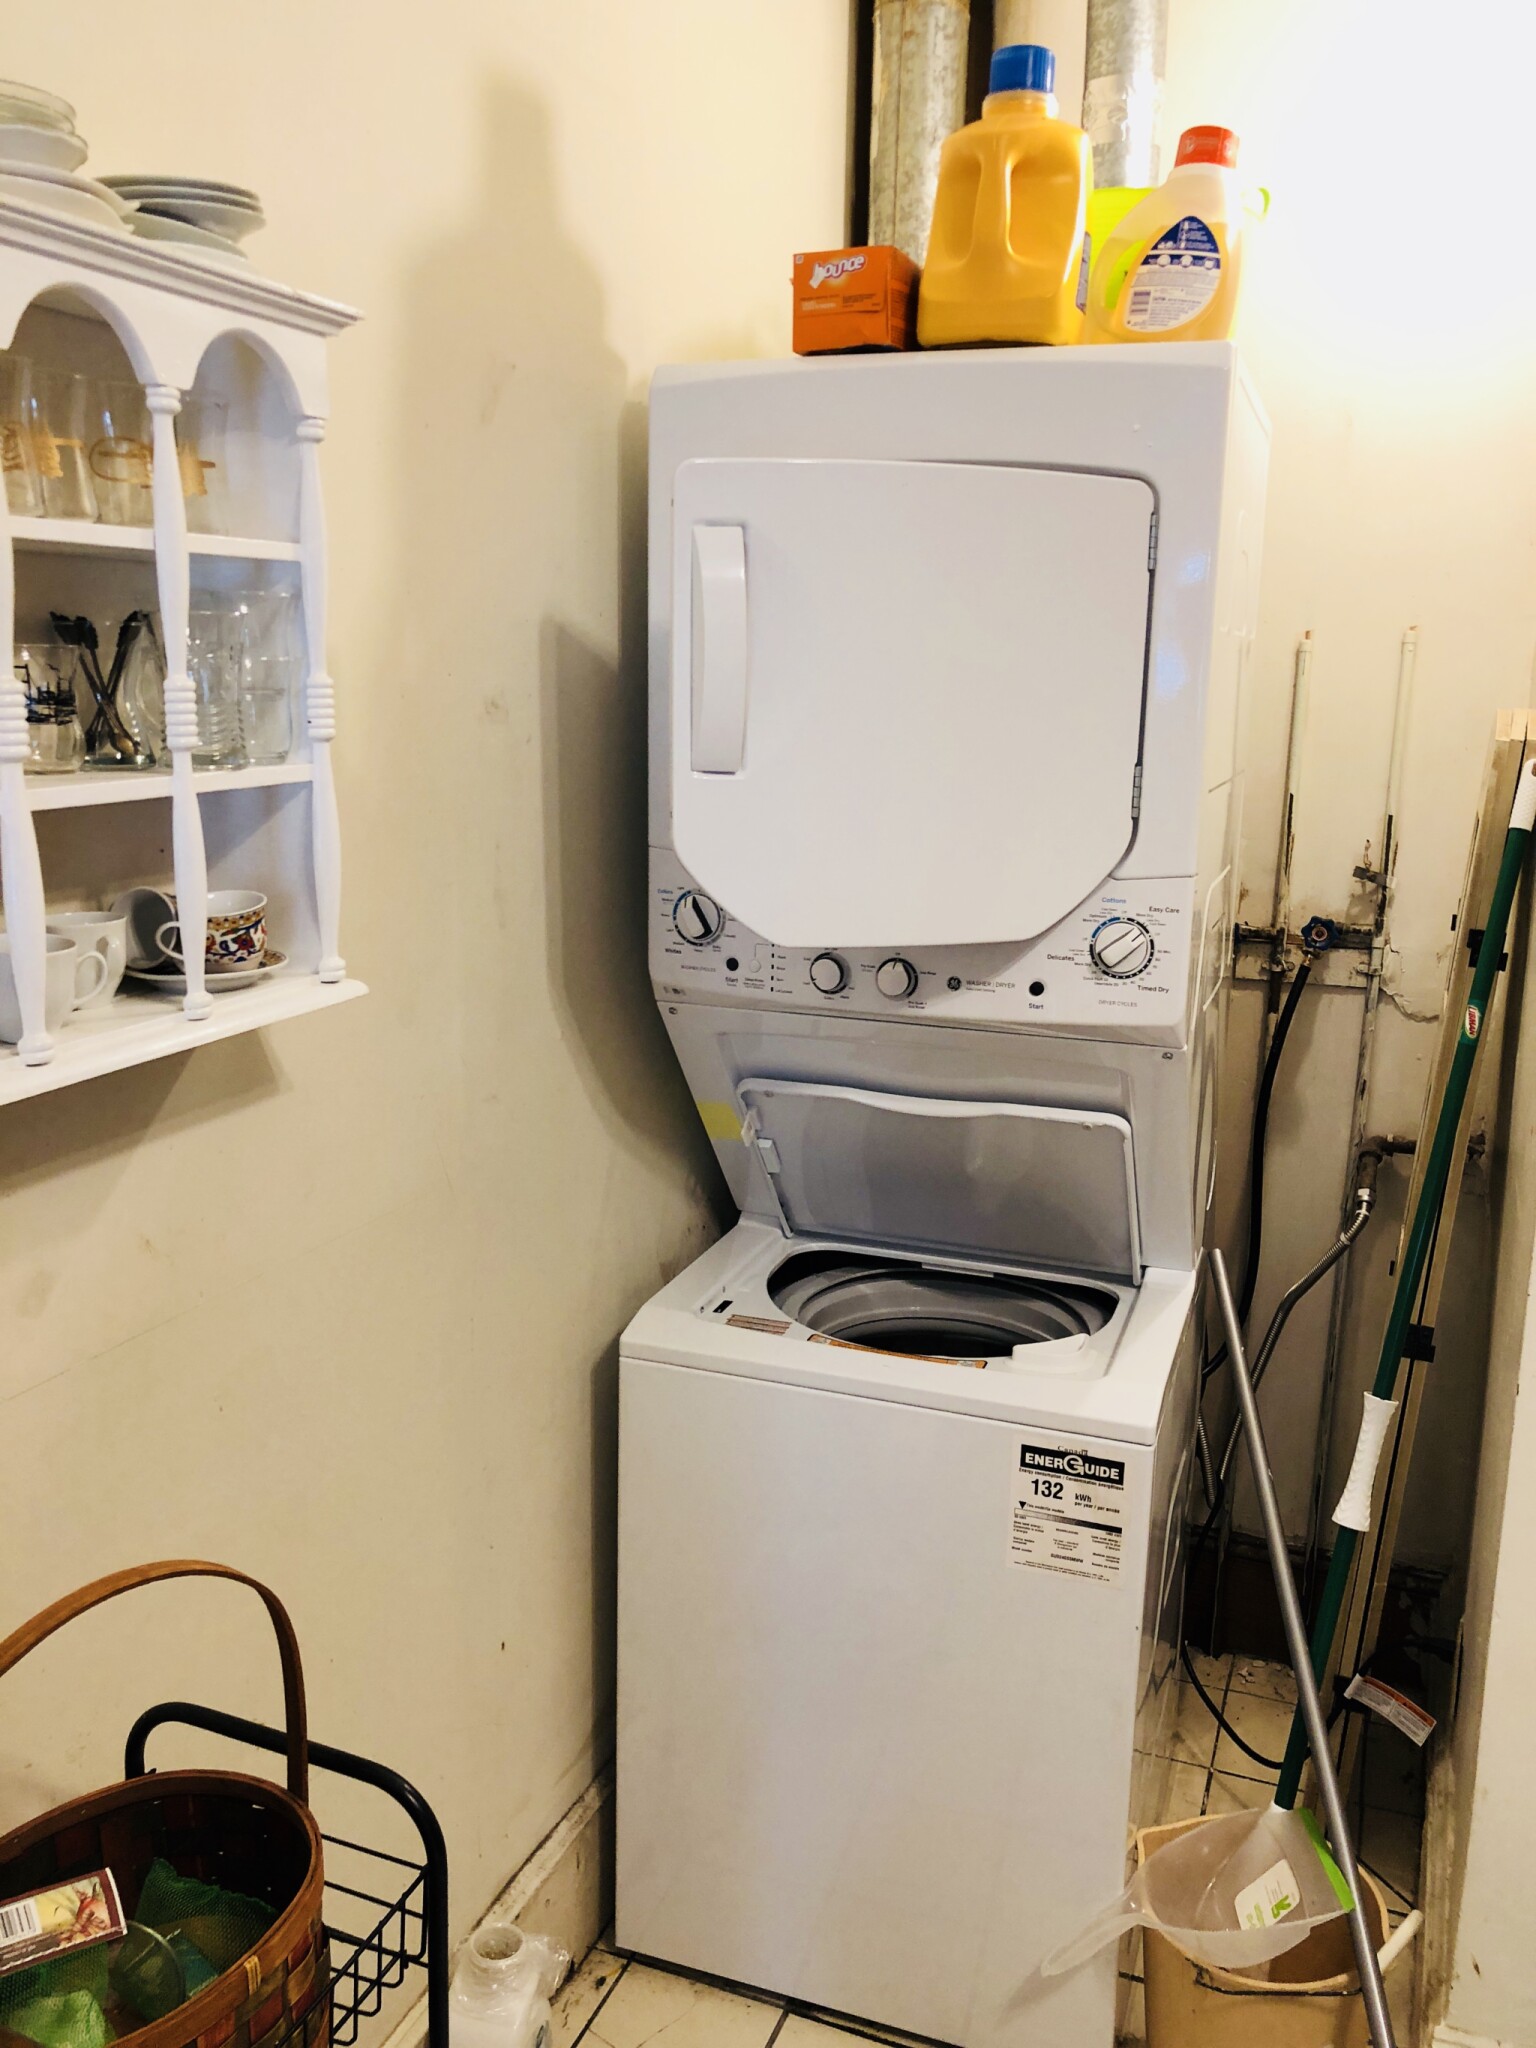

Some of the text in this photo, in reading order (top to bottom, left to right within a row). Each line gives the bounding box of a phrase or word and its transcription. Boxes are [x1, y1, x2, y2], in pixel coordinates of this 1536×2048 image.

[1047, 953, 1075, 961] Delicates
[1025, 1452, 1120, 1480] ENERGUIDE
[1031, 1479, 1064, 1500] 132
[1075, 1493, 1092, 1503] kWh
